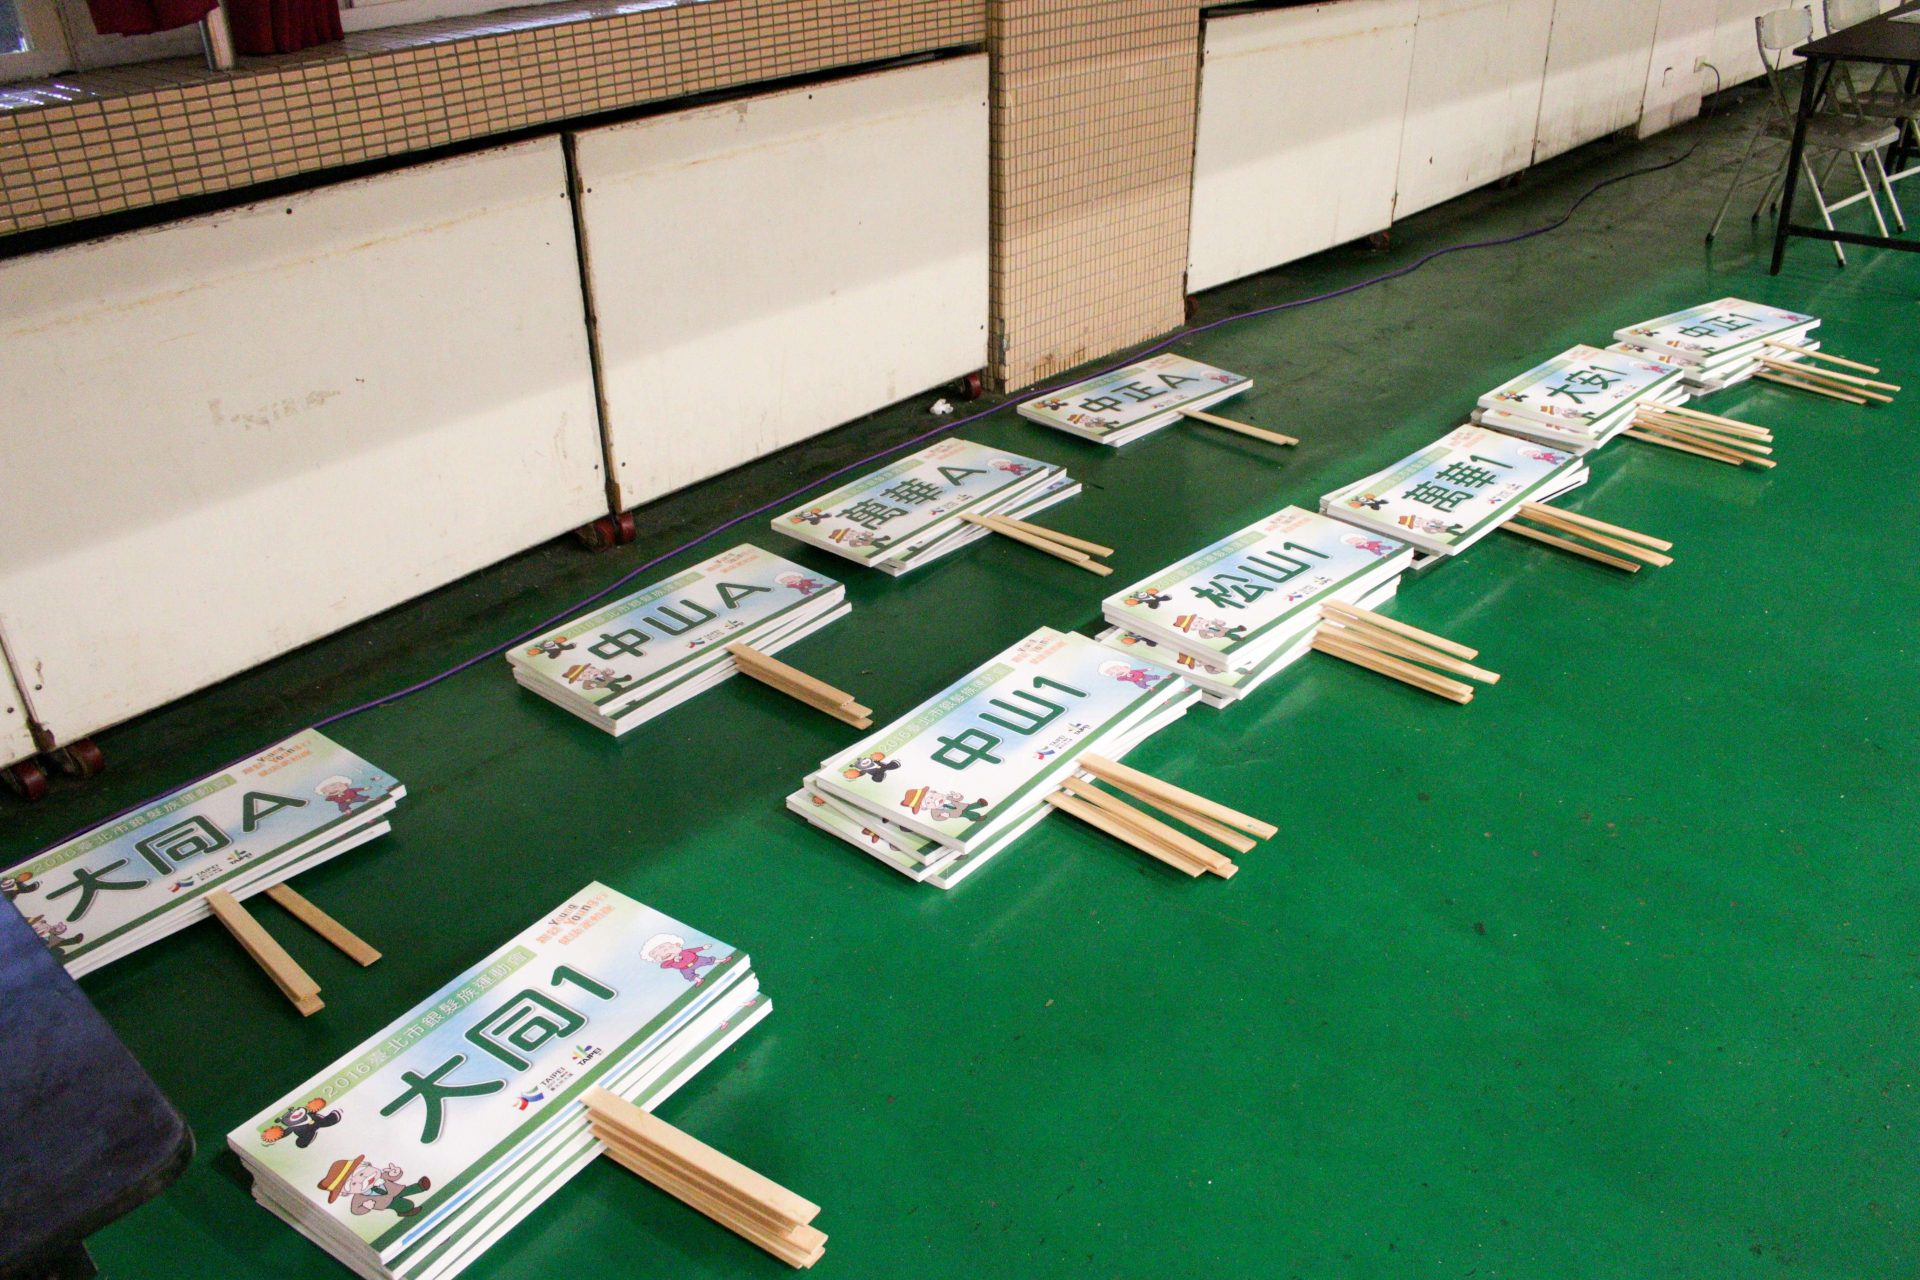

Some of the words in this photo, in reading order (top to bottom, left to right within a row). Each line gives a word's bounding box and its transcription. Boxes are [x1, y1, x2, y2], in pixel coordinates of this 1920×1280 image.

[1678, 313, 1762, 338] 中正1
[1078, 374, 1199, 412] 中正A
[1547, 365, 1628, 404] 大安1
[835, 466, 987, 530] 萬華A
[1402, 455, 1513, 513] 萬華1
[1191, 541, 1331, 609] 松山1
[587, 582, 772, 660] 中山A
[930, 676, 1088, 770] 中山1
[45, 790, 309, 922] 大同A
[379, 964, 617, 1143] 大同1
[541, 1066, 566, 1086] TAIPEI
[577, 1047, 602, 1066] TAIPEI
